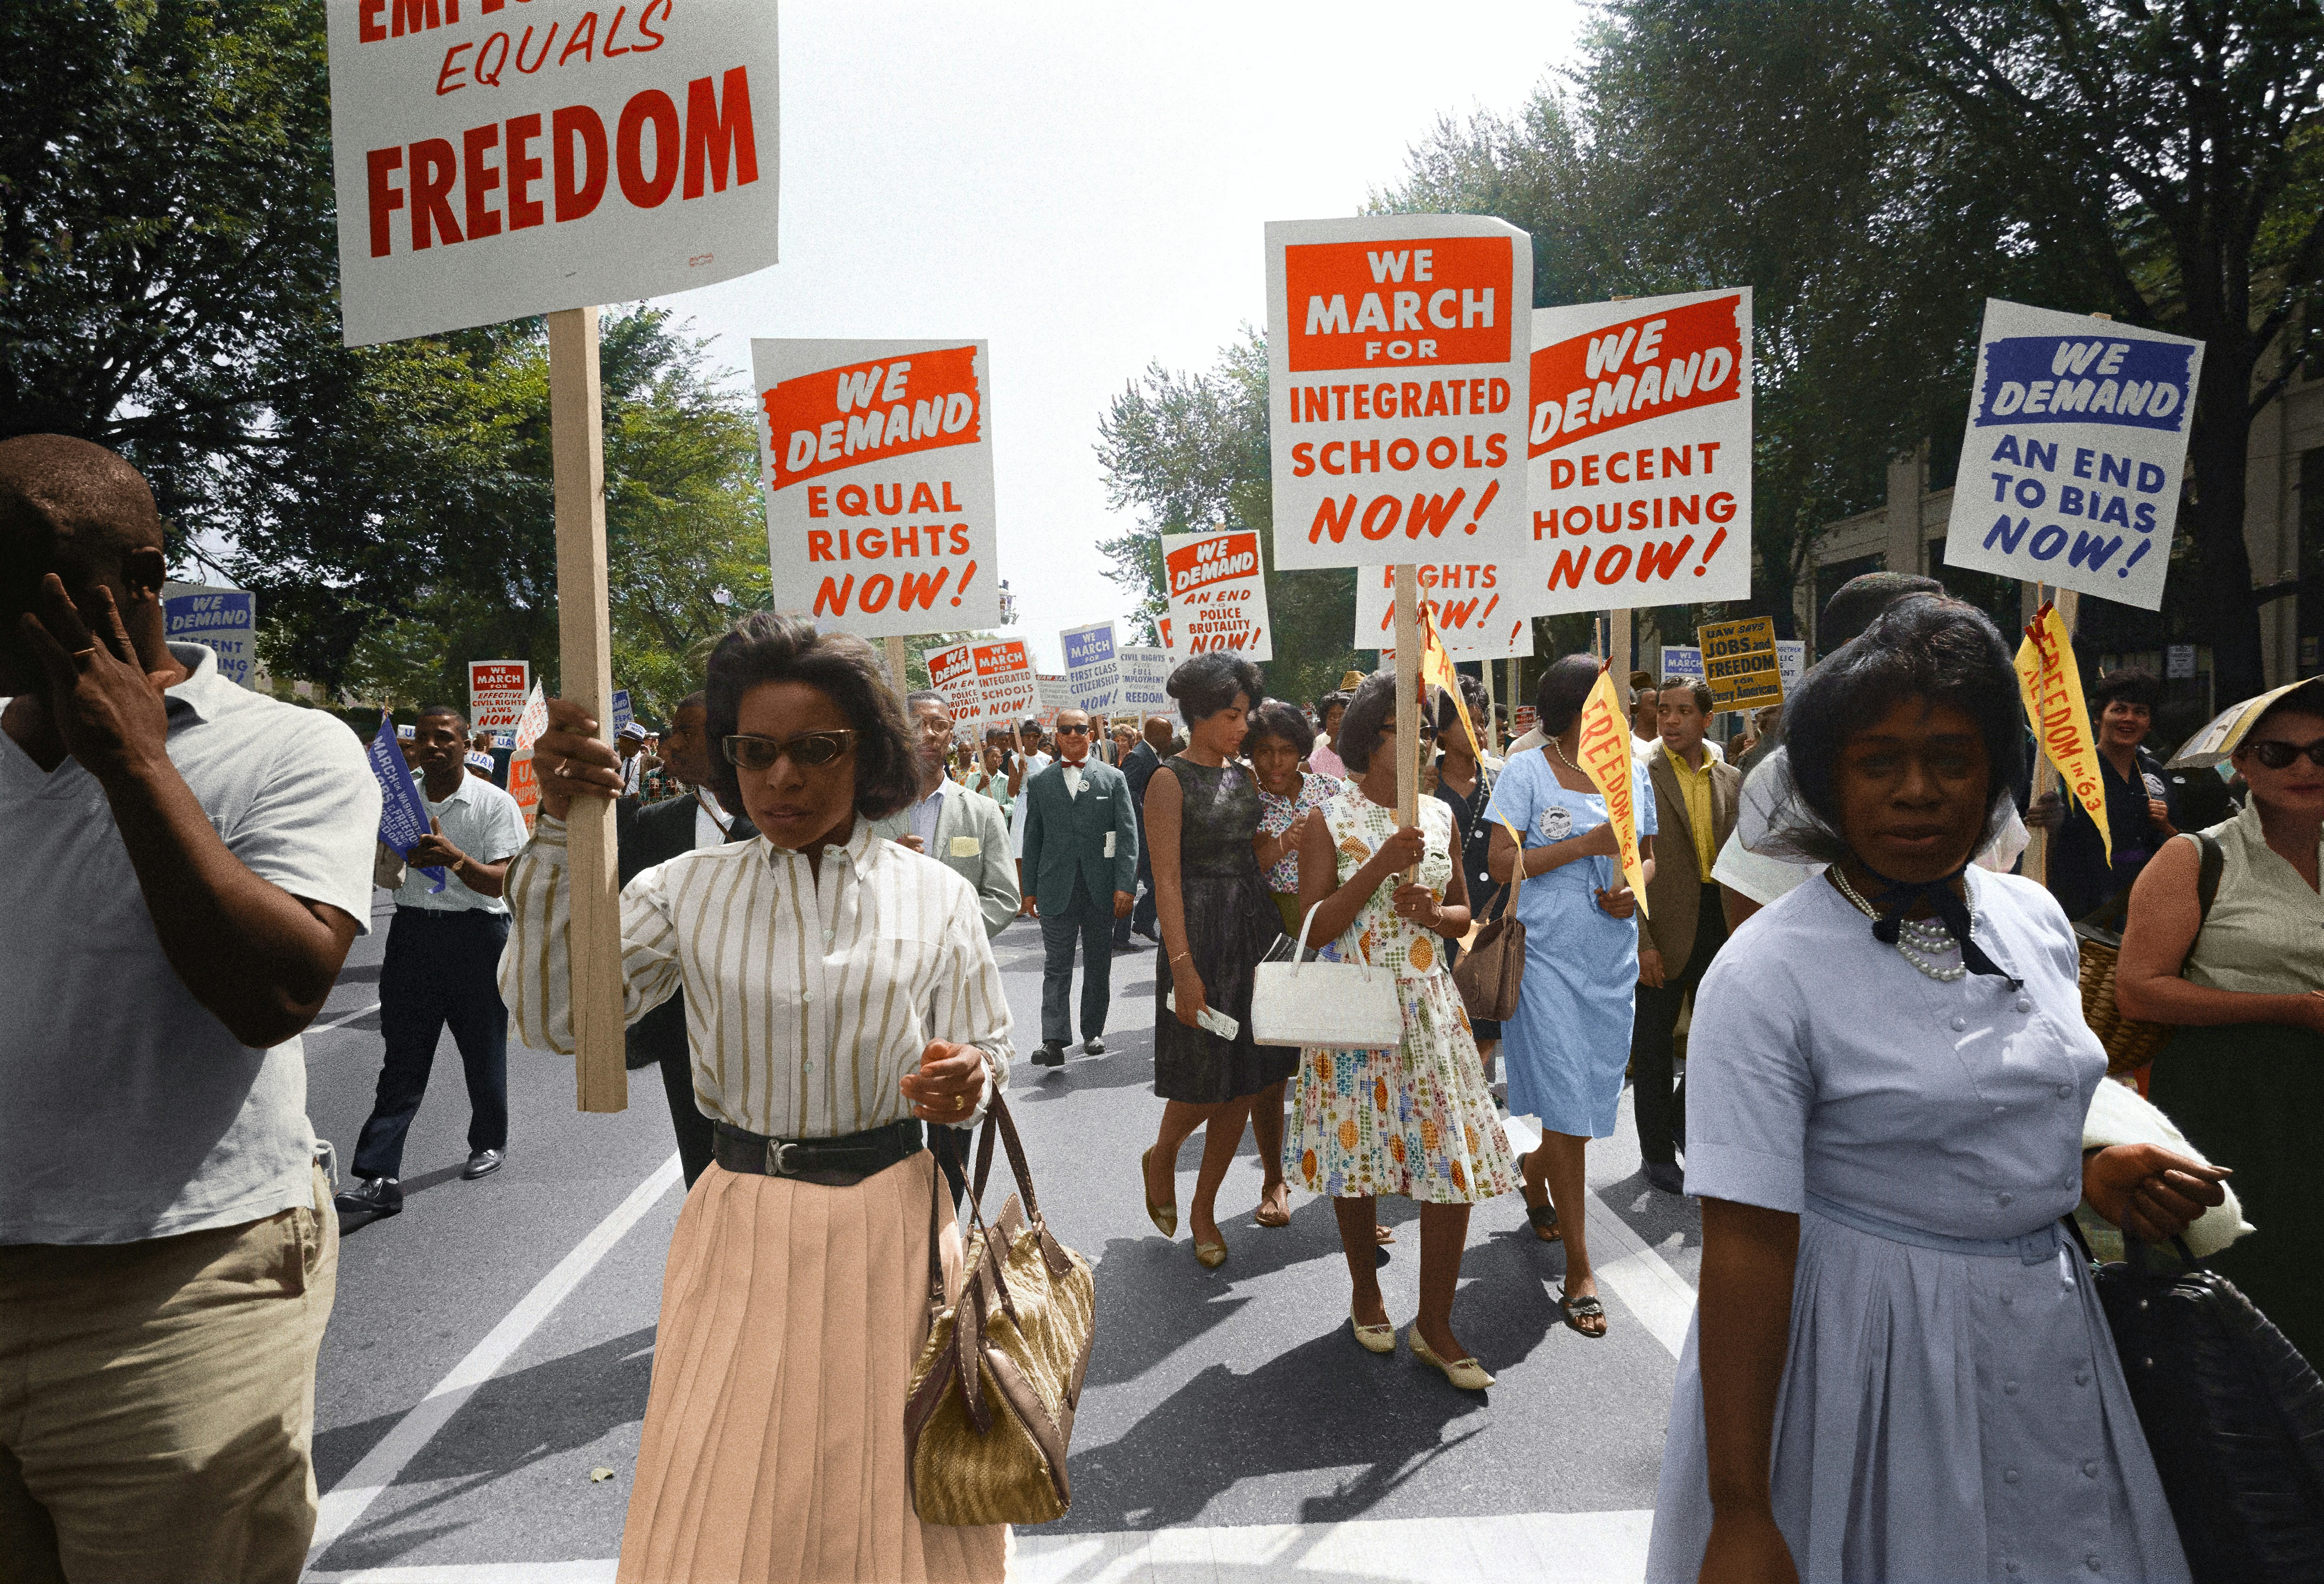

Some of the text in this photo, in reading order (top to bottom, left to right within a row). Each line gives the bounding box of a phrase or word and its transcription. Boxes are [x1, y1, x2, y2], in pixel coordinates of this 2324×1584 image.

[436, 0, 672, 95] EQUALS
[367, 65, 758, 258] FREEDOM
[1367, 249, 1433, 284] WE
[1305, 288, 1495, 335] MARCH
[1366, 339, 1438, 360] FOR
[1585, 319, 1667, 379] WE
[2052, 341, 2131, 376] WE
[837, 362, 911, 413] WE
[1530, 347, 1733, 445] DEMAND
[1991, 379, 2180, 417] DEMAND
[1290, 377, 1511, 422] INTEGRATED
[786, 393, 973, 472] DEMAND
[1292, 433, 1508, 477] SCHOOLS
[1550, 442, 1720, 490] DECENT
[1990, 435, 2165, 494] AN END
[808, 481, 962, 518] EQUAL
[1991, 472, 2156, 534] TO BIAS
[1308, 479, 1500, 544] NOW!
[1534, 492, 1737, 540] HOUSING
[808, 523, 970, 561] RIGHTS
[1197, 539, 1229, 562] WE
[1982, 514, 2151, 579] NOW!
[1547, 527, 1727, 591] NOW!
[1176, 552, 1254, 590] DEMAND
[1384, 564, 1497, 588] RGHTS
[813, 560, 977, 618] NOW!
[1184, 590, 1250, 604] AN END
[192, 596, 223, 611] WE
[1200, 607, 1241, 621] POLICE
[171, 610, 247, 630] DEMAND
[1189, 619, 1249, 634] BRUTALITY
[1083, 633, 1096, 642] WE
[1190, 627, 1261, 654] NOW!
[1706, 627, 1734, 639] UAW
[946, 648, 965, 665] WE
[991, 646, 1007, 654] WE
[1071, 640, 1110, 658] MARCH
[1706, 637, 1771, 658] JOBS and
[936, 659, 971, 683] DEMA
[979, 652, 1023, 667] MARCH
[1668, 659, 1702, 667] MARCH
[1707, 654, 1776, 678] FREEDOM
[477, 675, 521, 684] MARCH
[979, 672, 1031, 688] INTEGRATED
[1070, 663, 1117, 682] FIRST CLASS
[1734, 677, 1754, 685] FOR
[942, 679, 974, 692] AN EN
[952, 689, 977, 700] POLICE
[982, 684, 1033, 700] SCHOOLS
[1070, 675, 1119, 694] CITIZENSHIP
[1737, 685, 1778, 698] American
[948, 697, 978, 709] BRUTALIT
[990, 695, 1033, 715] NOW!
[1080, 688, 1118, 711] NOW!
[1125, 692, 1163, 703] REEDOM
[478, 714, 522, 726] NOW!
[1579, 698, 1630, 824] FREEDOM
[2071, 762, 2084, 778] IN
[374, 735, 398, 783] MARCH
[397, 791, 421, 835] WASHINGT
[2077, 777, 2102, 811] '63
